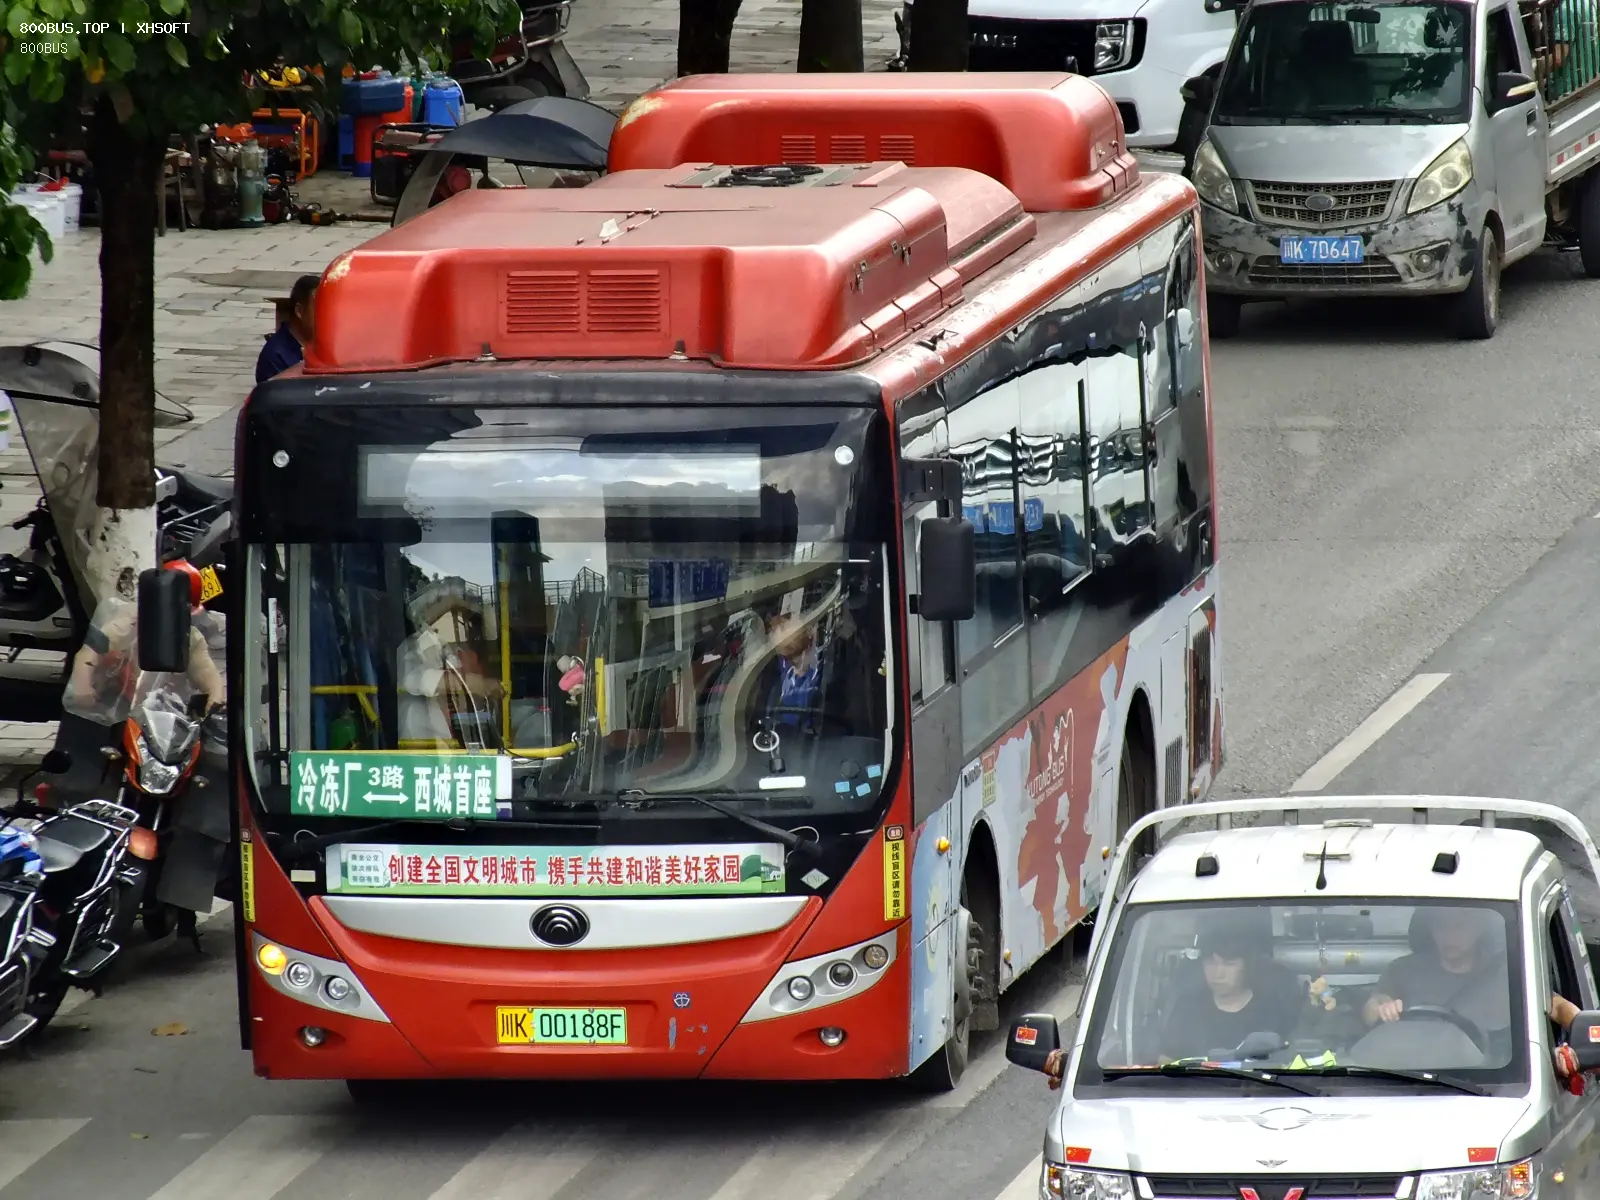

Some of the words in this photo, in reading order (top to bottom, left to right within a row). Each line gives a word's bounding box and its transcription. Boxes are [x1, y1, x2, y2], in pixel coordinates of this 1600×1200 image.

[297, 757, 362, 813] 冷冻厂
[368, 766, 404, 789] 3路
[413, 763, 493, 814] 西城首座
[388, 854, 537, 885] 创建全国文明城市
[548, 854, 741, 886] 携手共建和谐美好家园
[891, 842, 901, 918] 视线盲区请勿靠近
